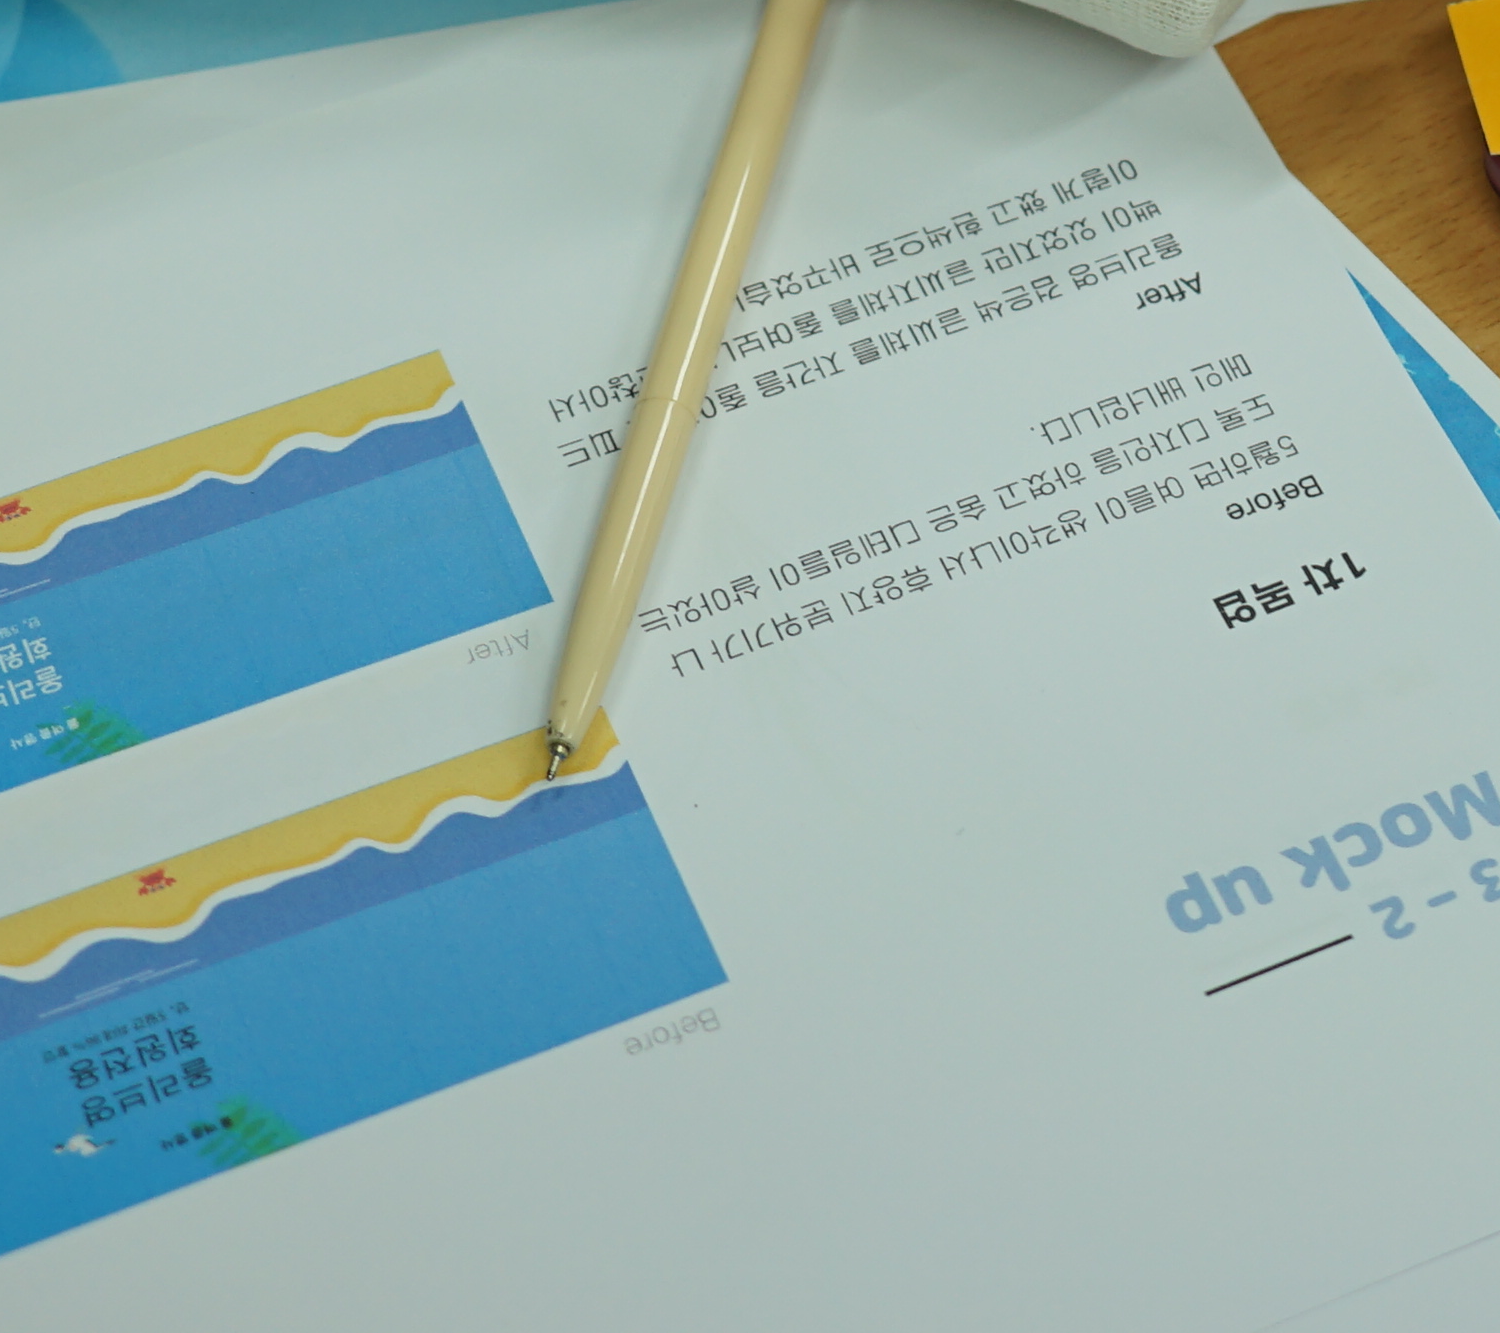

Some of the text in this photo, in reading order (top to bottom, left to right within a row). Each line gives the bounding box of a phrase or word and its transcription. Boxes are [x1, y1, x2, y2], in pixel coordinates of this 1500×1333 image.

[733, 159, 1138, 313] 이렇게 했고 흰색으로 바꾸었습
[981, 217, 1097, 274] 있었지만
[1101, 199, 1162, 233] 백이
[753, 232, 1183, 399] 올리브영 검은색 글씨체를 자간을
[829, 258, 976, 326] 글씨자체를
[1136, 271, 1202, 311] After
[548, 364, 653, 423] 찮아서
[1030, 353, 1253, 446] 메인 배너입니다.
[558, 428, 624, 468] 피드
[637, 393, 1275, 633] 도록 디자인을 하였고 숨은 디테일들이 살아있는
[1225, 473, 1325, 521] Before
[670, 434, 1299, 678] 5월하면 여름이 생각이나서 휴양지 분위기가 나
[1211, 551, 1368, 630] 1차 목업
[467, 629, 532, 666] After
[1166, 866, 1273, 933] up
[1370, 896, 1415, 940] 2
[69, 1028, 200, 1089] 회원전용
[623, 1007, 721, 1056] Before
[85, 1058, 212, 1128] 올리브영
